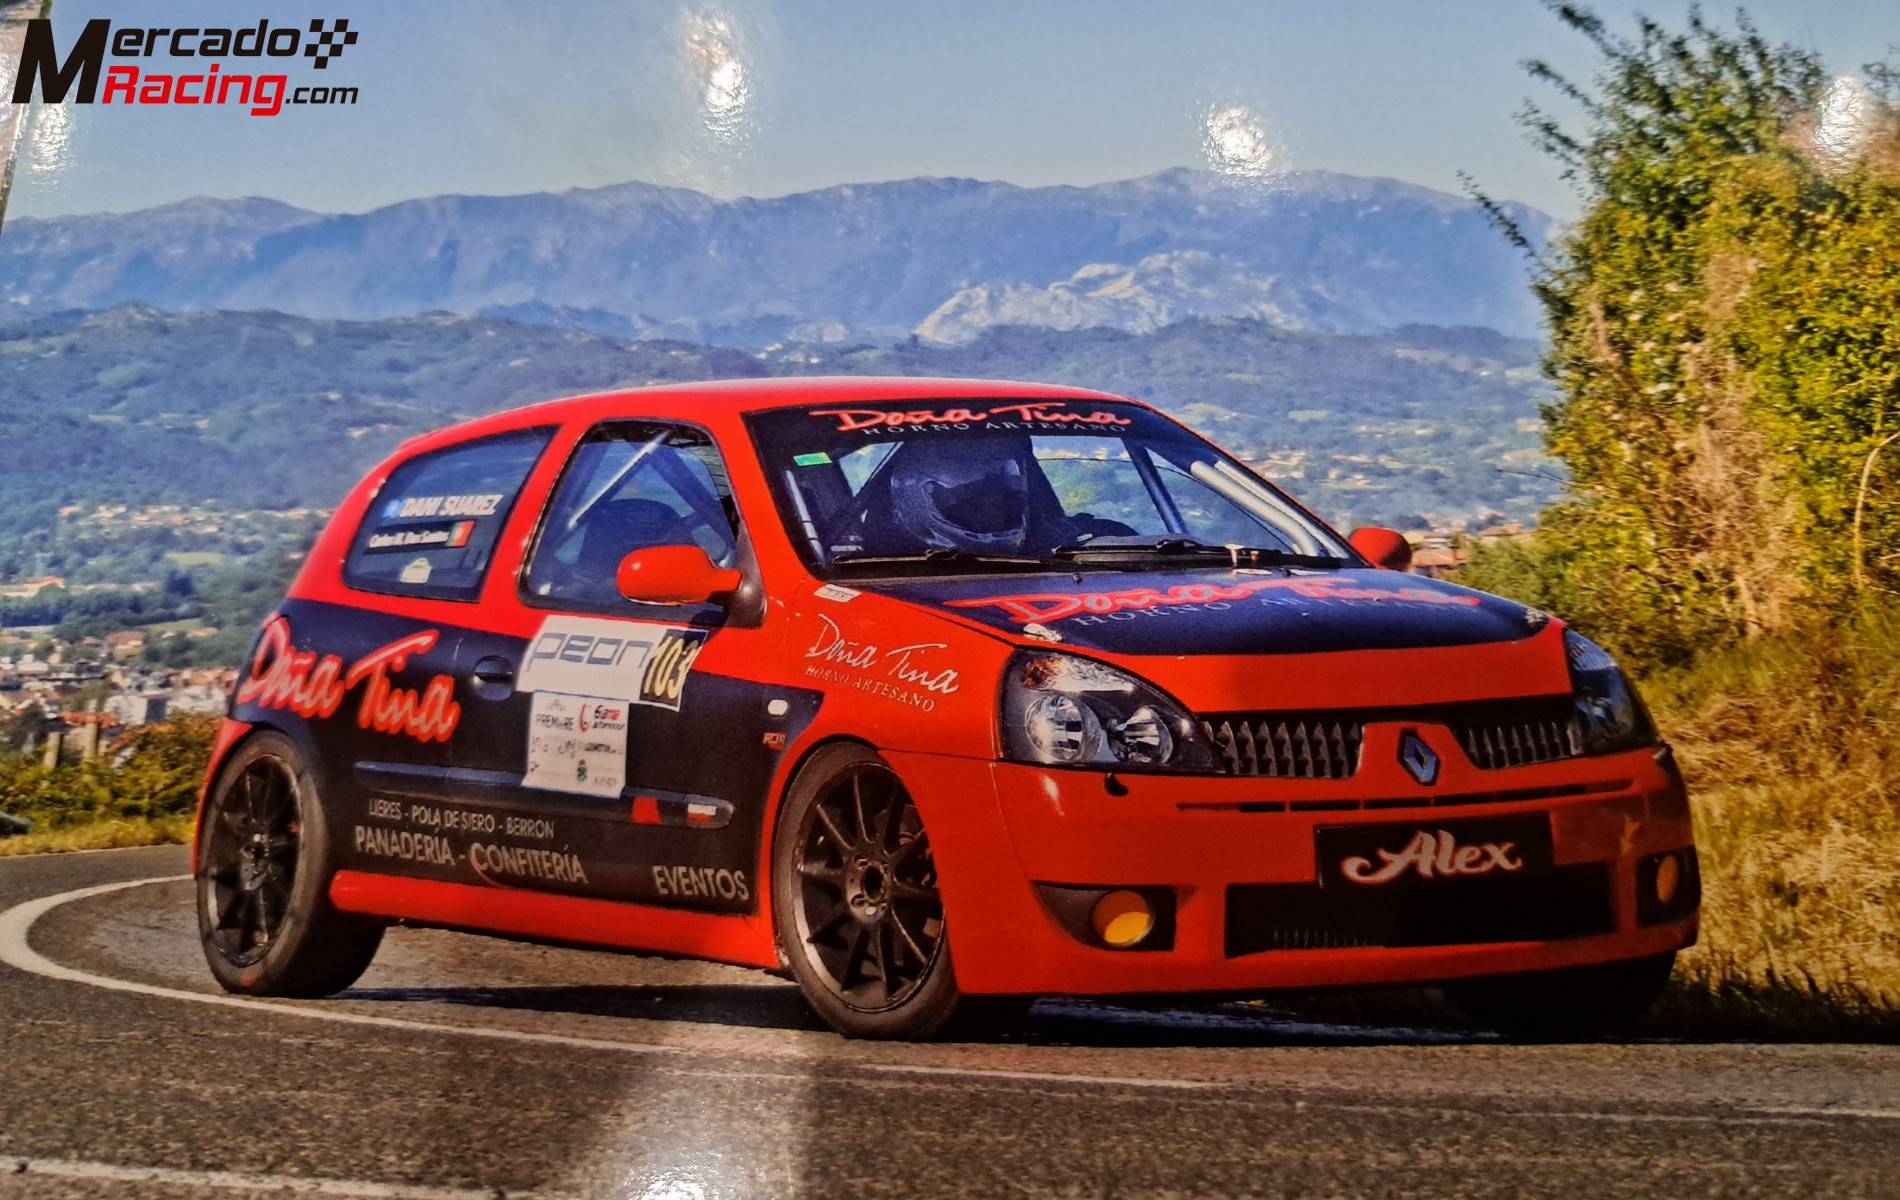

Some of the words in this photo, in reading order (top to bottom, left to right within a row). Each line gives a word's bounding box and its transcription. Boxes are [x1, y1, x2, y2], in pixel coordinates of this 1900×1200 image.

[809, 408, 988, 431] Doña
[989, 402, 1132, 426] Tina
[861, 422, 970, 436] HORNO
[985, 421, 1127, 433] ARTESANO
[400, 497, 441, 517] DANI
[943, 583, 1253, 625] Doña
[1240, 576, 1480, 606] Tina
[1071, 600, 1233, 626] HORNO
[237, 611, 346, 719] Doña
[346, 629, 461, 742] Tina
[643, 635, 702, 699] 103
[804, 613, 878, 668] Doña
[885, 643, 959, 694] Tina
[805, 665, 850, 685] HORNO
[852, 676, 935, 712] ARTESANO
[369, 799, 401, 820] LIERES
[411, 804, 441, 826] POLA
[443, 809, 460, 828] DE
[461, 813, 496, 833] SIERO
[355, 826, 455, 866] PANADERÍA
[470, 843, 589, 884] CONFITERÍA
[1340, 829, 1523, 885] Alex
[652, 865, 749, 900] EVENTOS
